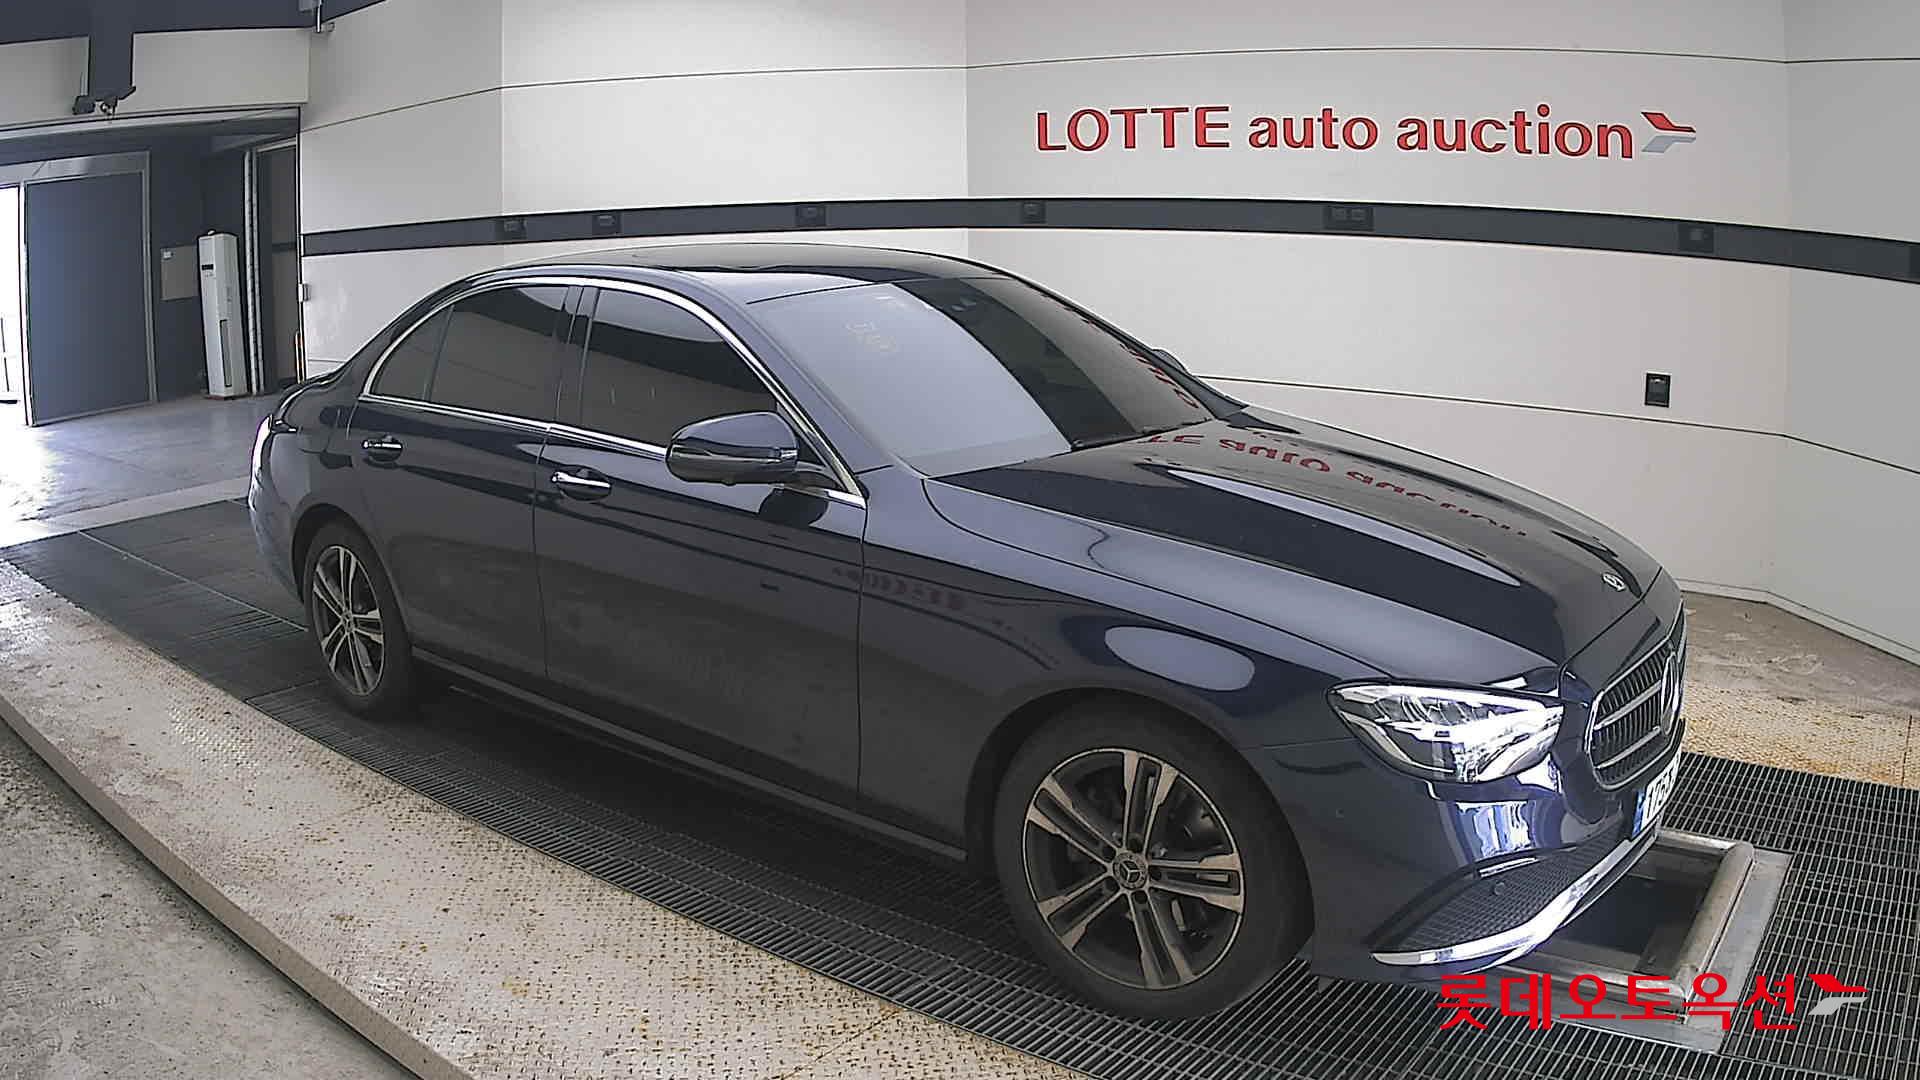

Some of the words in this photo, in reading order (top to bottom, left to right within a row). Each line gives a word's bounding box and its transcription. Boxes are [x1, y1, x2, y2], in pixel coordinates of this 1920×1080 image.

[1037, 105, 1230, 152] LOTTE
[1248, 108, 1379, 151] auto
[1397, 103, 1634, 159] auction
